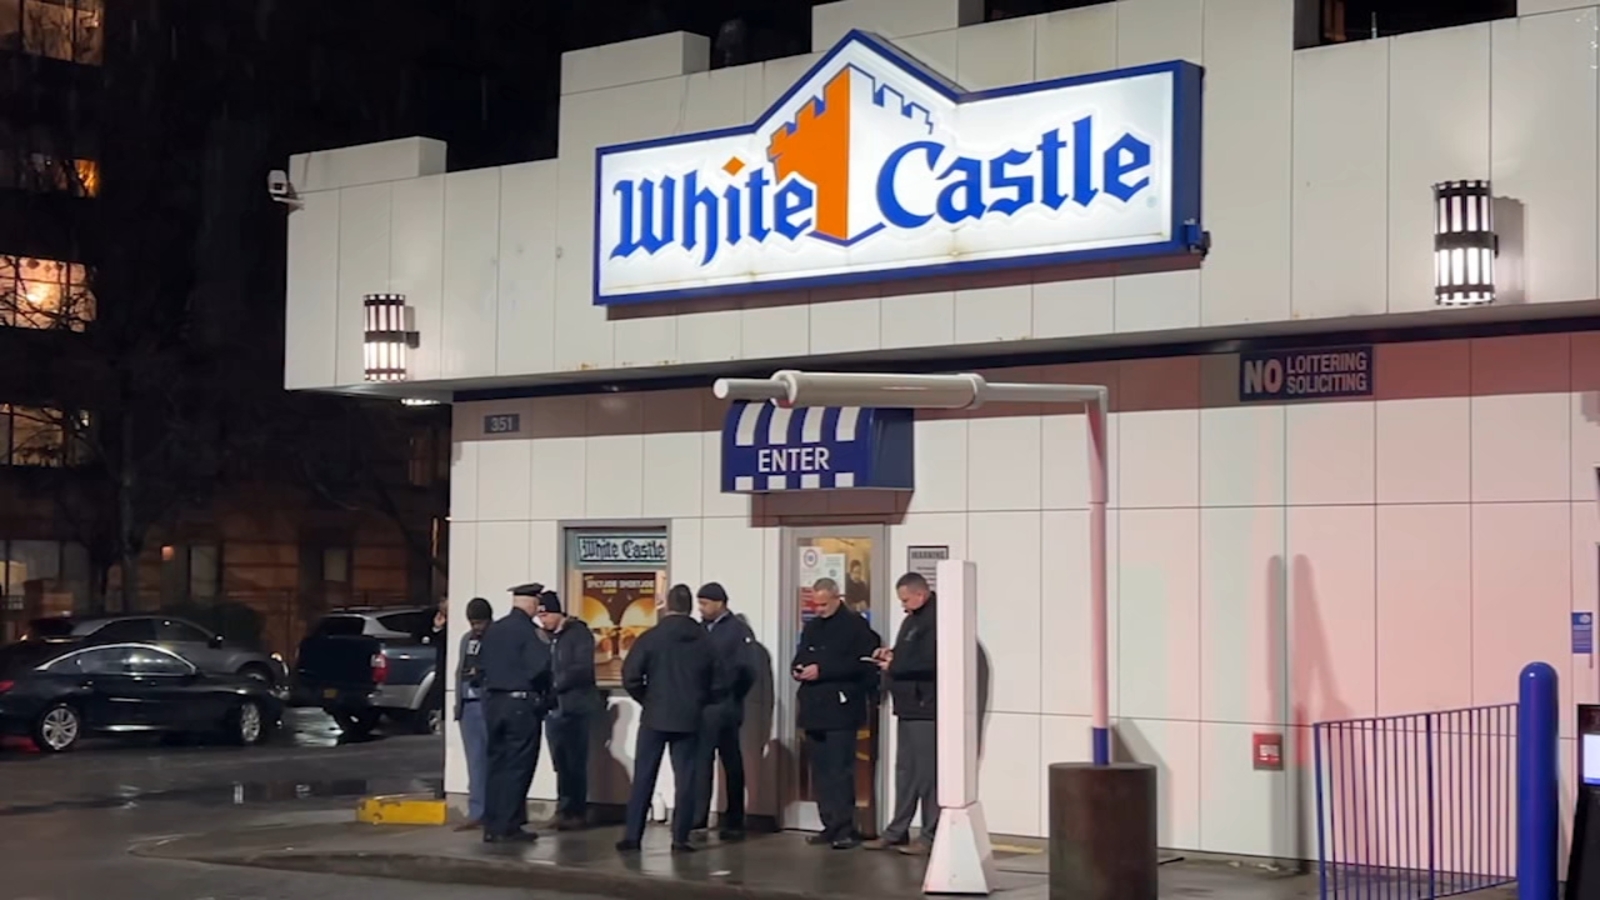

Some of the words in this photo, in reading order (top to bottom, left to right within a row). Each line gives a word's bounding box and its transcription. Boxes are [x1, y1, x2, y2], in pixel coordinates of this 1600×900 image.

[609, 155, 815, 266] White
[876, 114, 1152, 229] Castle
[1286, 352, 1367, 374] LOITERING
[1244, 359, 1283, 394] NO
[1286, 373, 1367, 394] SOLICITING
[490, 416, 513, 431] 351
[758, 447, 830, 472] ENTER
[582, 538, 619, 560] White
[622, 539, 666, 559] Castle
